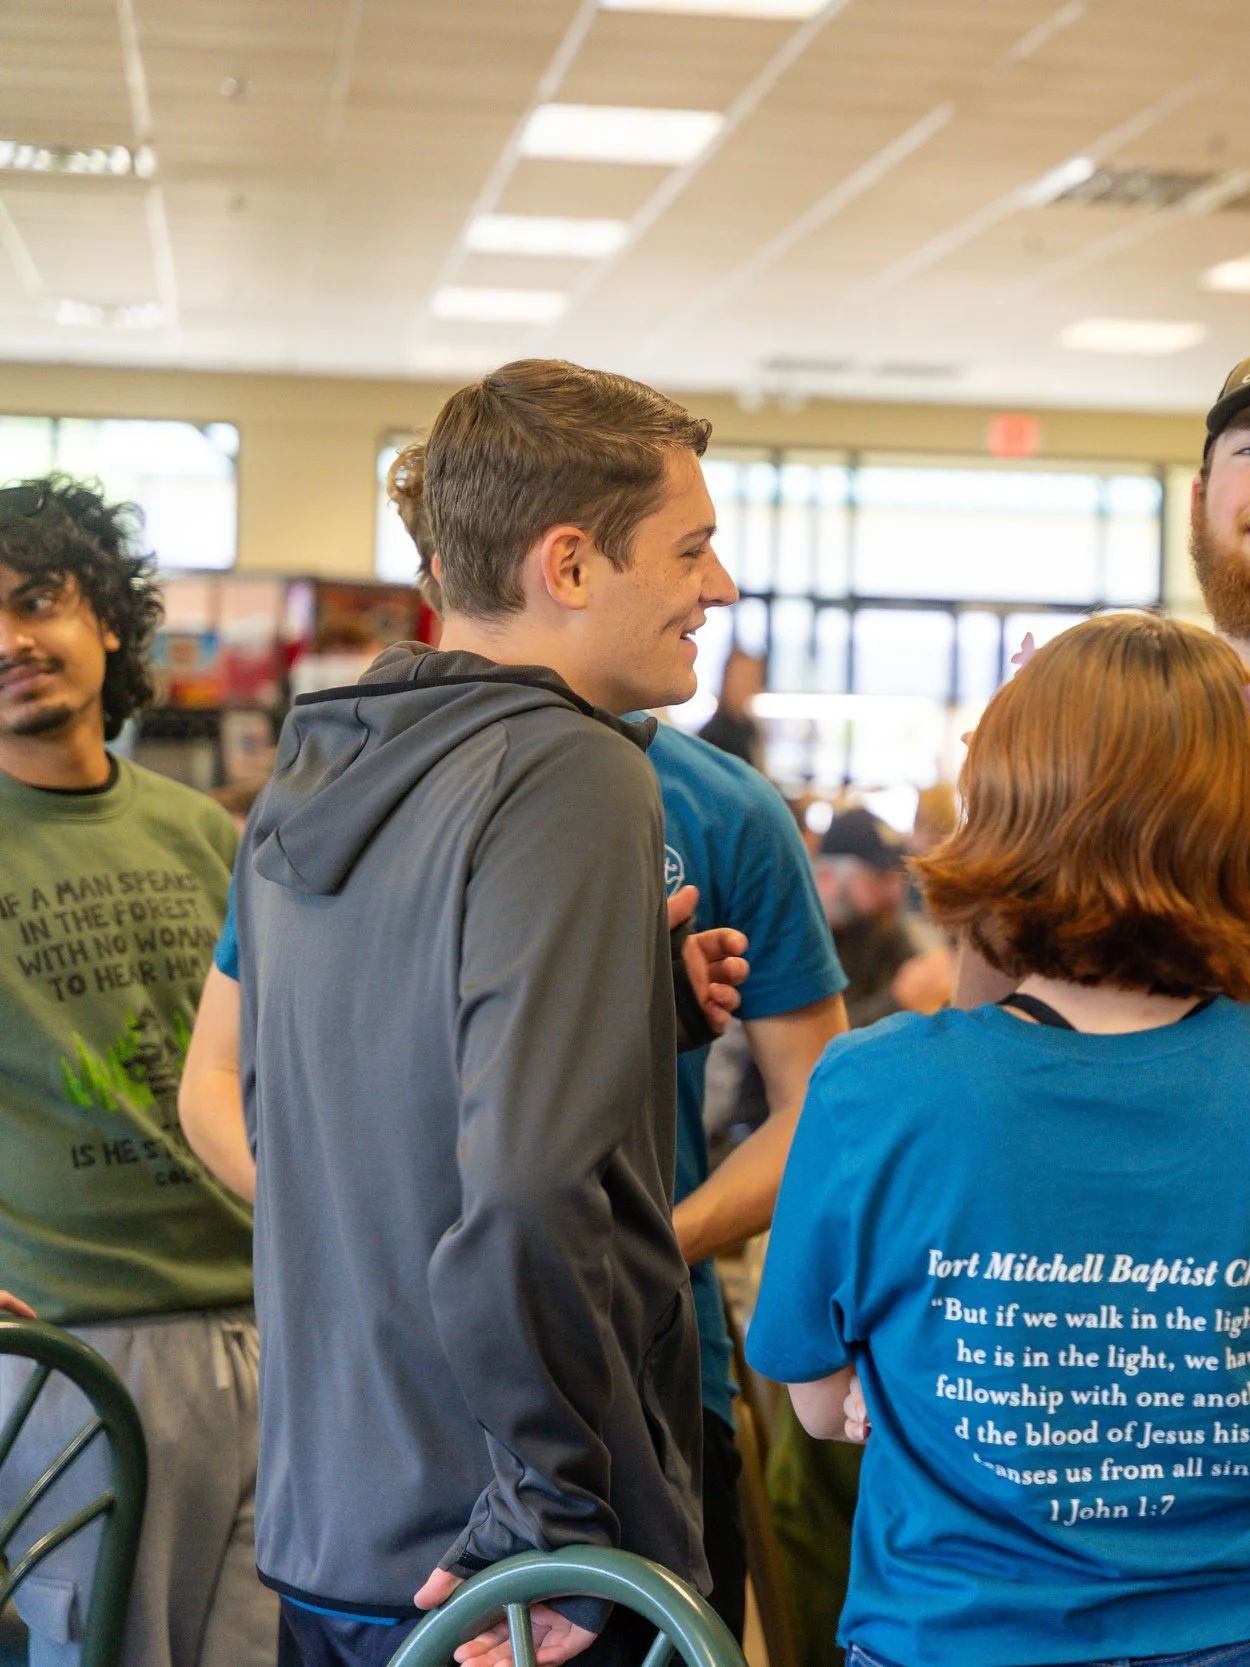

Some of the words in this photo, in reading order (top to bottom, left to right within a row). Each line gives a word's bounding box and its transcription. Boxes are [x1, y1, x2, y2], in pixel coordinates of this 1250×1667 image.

[0, 892, 20, 920] IF
[31, 885, 50, 912] A
[55, 873, 114, 905] MAN
[117, 869, 200, 896] SPEAKS
[19, 916, 51, 946] IN
[53, 903, 110, 934] THE
[112, 897, 197, 927] FOREST
[16, 938, 90, 978] WITH
[93, 933, 128, 959] NO
[133, 924, 218, 955] WOMAN
[46, 973, 87, 1002] TO
[92, 960, 157, 993] HEAR
[71, 1142, 96, 1169] IS
[102, 1138, 138, 1166] HE
[927, 1248, 980, 1278] Fort
[983, 1251, 1105, 1283] Mitchell
[1108, 1254, 1217, 1291] Baptist
[996, 1303, 1020, 1327] if
[1023, 1313, 1057, 1328] we
[1065, 1305, 1123, 1329] walk
[1131, 1307, 1158, 1330] in
[1166, 1307, 1207, 1332] the
[957, 1339, 987, 1365] he
[994, 1345, 1015, 1367] is
[1023, 1346, 1049, 1367] in
[1058, 1344, 1100, 1368] the
[1108, 1344, 1175, 1377] light,
[1184, 1354, 1219, 1371] we
[936, 1375, 1064, 1415] fellowship
[1071, 1383, 1127, 1406] with
[1136, 1392, 1185, 1408] one
[977, 1420, 1018, 1446] the
[1025, 1420, 1098, 1446] blood
[1107, 1421, 1139, 1443] of
[1138, 1422, 1205, 1449] Jesus
[1214, 1421, 1250, 1444] his
[1065, 1467, 1092, 1483] us
[1101, 1457, 1164, 1481] from
[1172, 1457, 1203, 1478] all
[1063, 1497, 1129, 1526] John
[1138, 1495, 1175, 1517] 1:7
